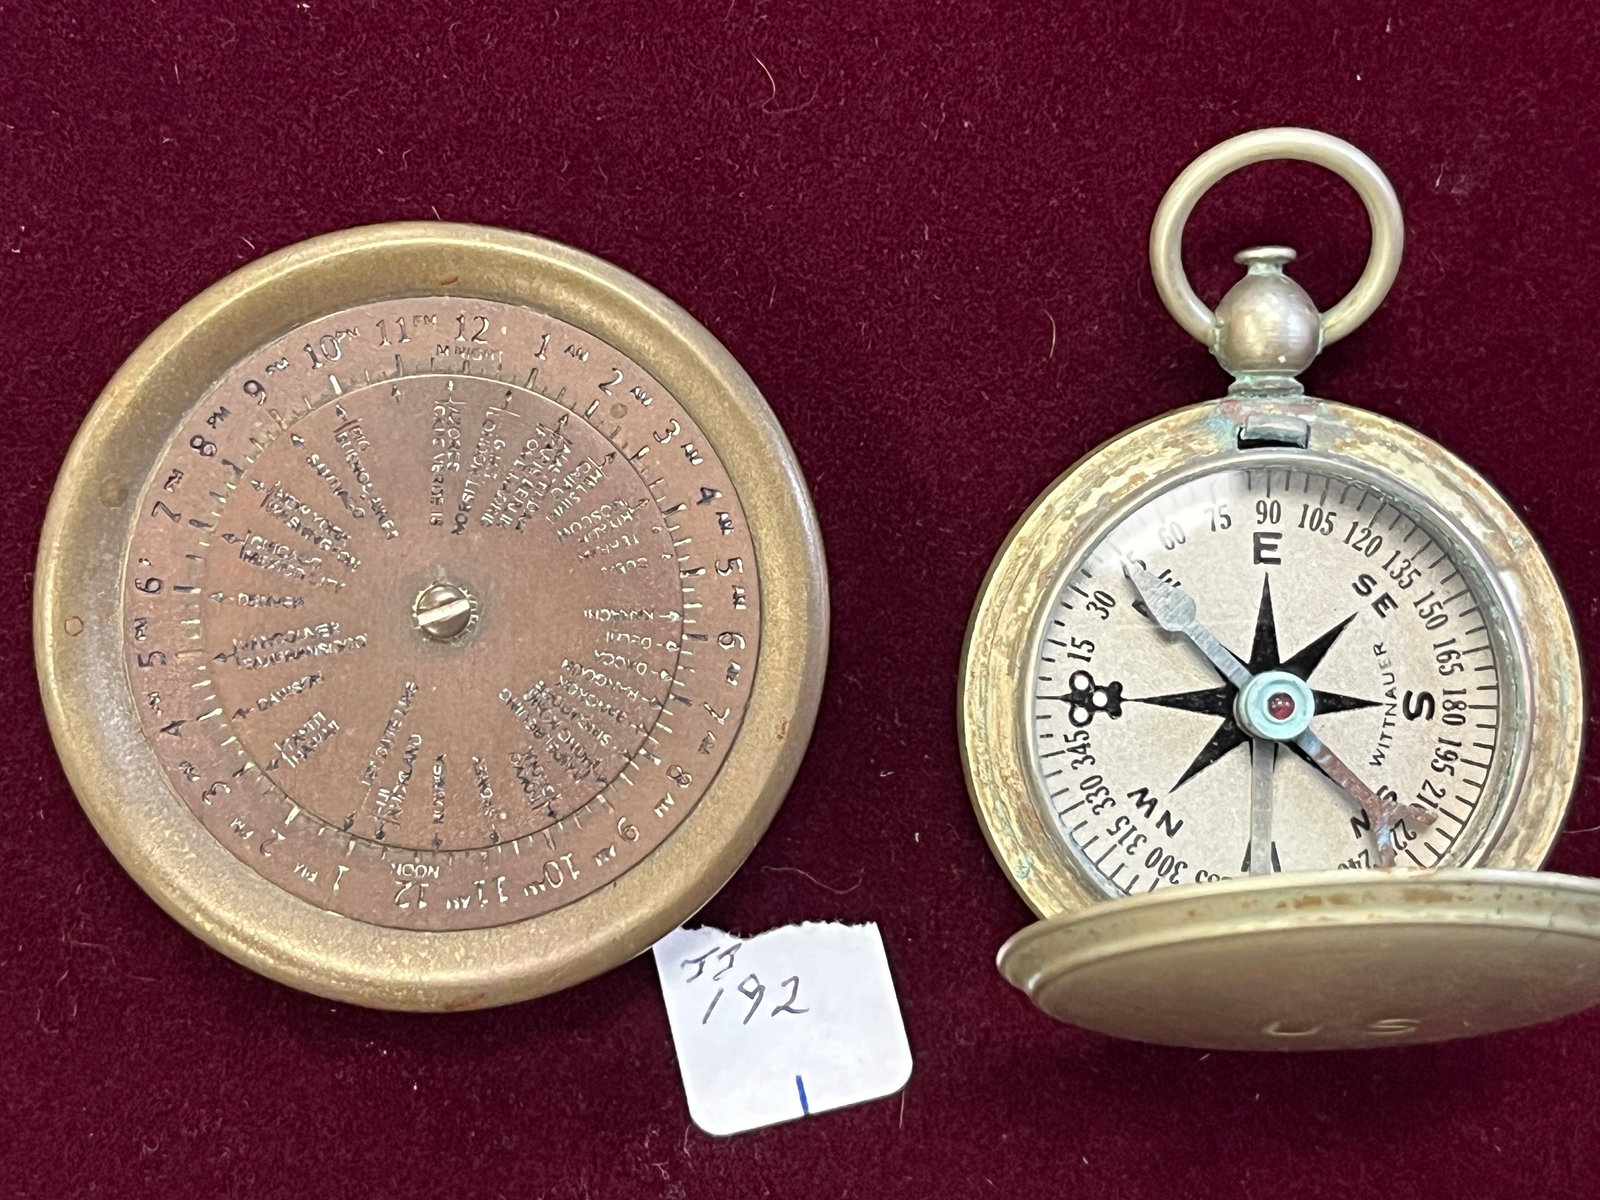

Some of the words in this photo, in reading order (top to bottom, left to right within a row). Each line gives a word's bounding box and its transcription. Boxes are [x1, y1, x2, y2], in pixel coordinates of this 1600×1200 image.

[456, 315, 489, 343] 12
[535, 333, 550, 360] 1
[243, 380, 267, 406] 9
[599, 368, 624, 396] 2
[189, 434, 217, 457] 8
[653, 419, 681, 444] 3
[451, 479, 481, 536] LISBON
[697, 487, 723, 505] 4
[151, 501, 182, 523] 7
[1204, 504, 1232, 532] 75
[1257, 500, 1281, 524] 90
[1298, 503, 1337, 535] 105
[1158, 521, 1186, 551] 60
[1253, 532, 1282, 565] E
[1342, 520, 1384, 558] 120
[715, 557, 743, 577] 5
[1381, 551, 1416, 589] 135
[134, 576, 163, 594] 6
[1351, 573, 1398, 619] SE
[1086, 590, 1116, 620] 30
[1413, 591, 1449, 631] 150
[718, 631, 746, 650] 6
[1067, 636, 1096, 664] 15
[137, 651, 167, 667] 5
[1433, 637, 1463, 676] 165
[703, 702, 730, 724] 7
[1370, 643, 1397, 767] WITTNAUER
[1402, 691, 1435, 722] S
[1442, 688, 1467, 727] 180
[159, 720, 185, 737] 4
[1064, 727, 1096, 770] 345
[1431, 736, 1464, 777] 195
[667, 764, 693, 788] 8
[202, 781, 231, 805] 3
[1080, 775, 1116, 815] 330
[1126, 786, 1184, 838] NW
[260, 828, 285, 857] 2
[617, 816, 639, 842] 9
[1106, 815, 1147, 855] 315
[1390, 819, 1417, 853] 22
[333, 865, 349, 891] 1
[391, 863, 440, 879] NOON
[1144, 846, 1188, 884] 300
[394, 880, 428, 910] 12
[702, 973, 810, 1025] 192
